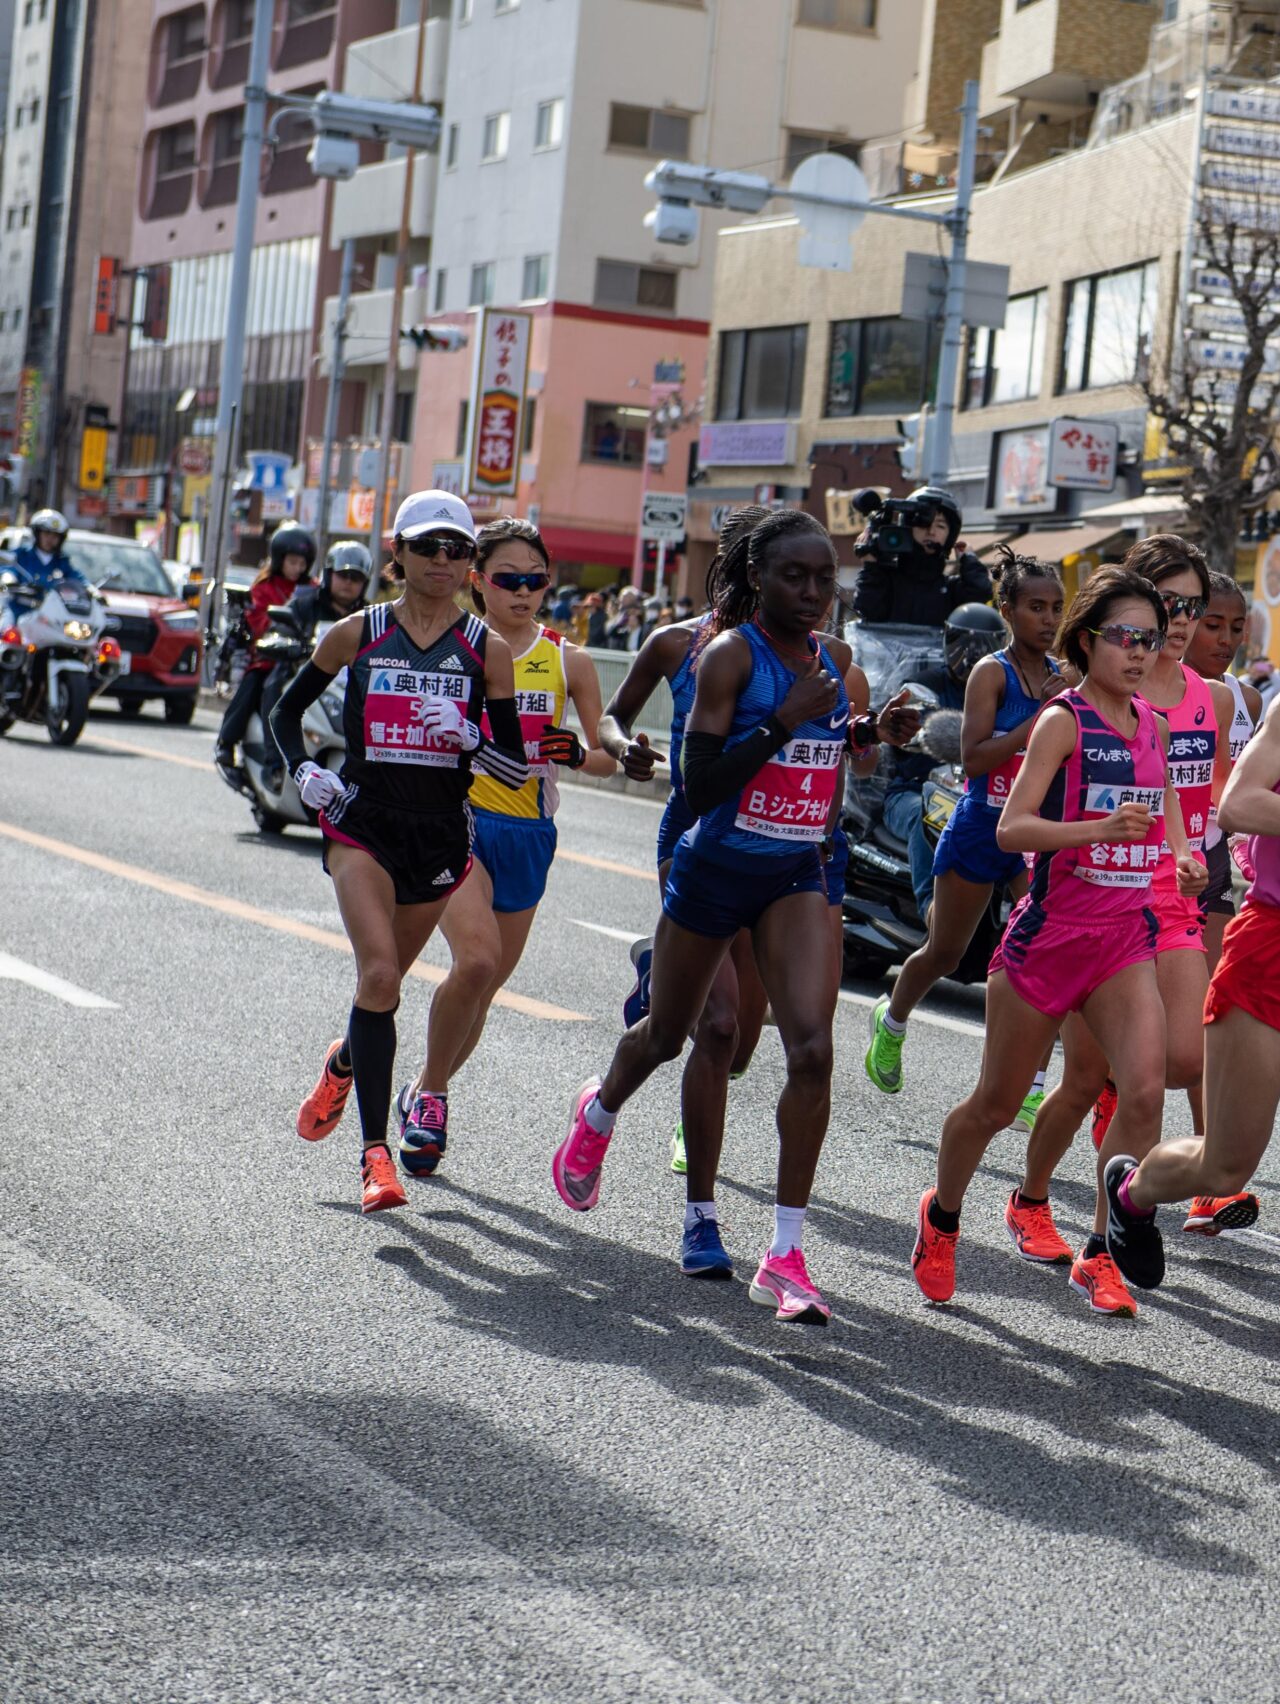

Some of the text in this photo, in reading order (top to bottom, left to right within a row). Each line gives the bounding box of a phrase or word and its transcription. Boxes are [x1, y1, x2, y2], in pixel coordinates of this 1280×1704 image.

[481, 407, 514, 470] 王将
[368, 657, 411, 669] WACOAL
[439, 663, 464, 671] adidas
[394, 673, 464, 698] 奥村組
[1083, 748, 1131, 763] てんまや
[800, 772, 814, 794] 4
